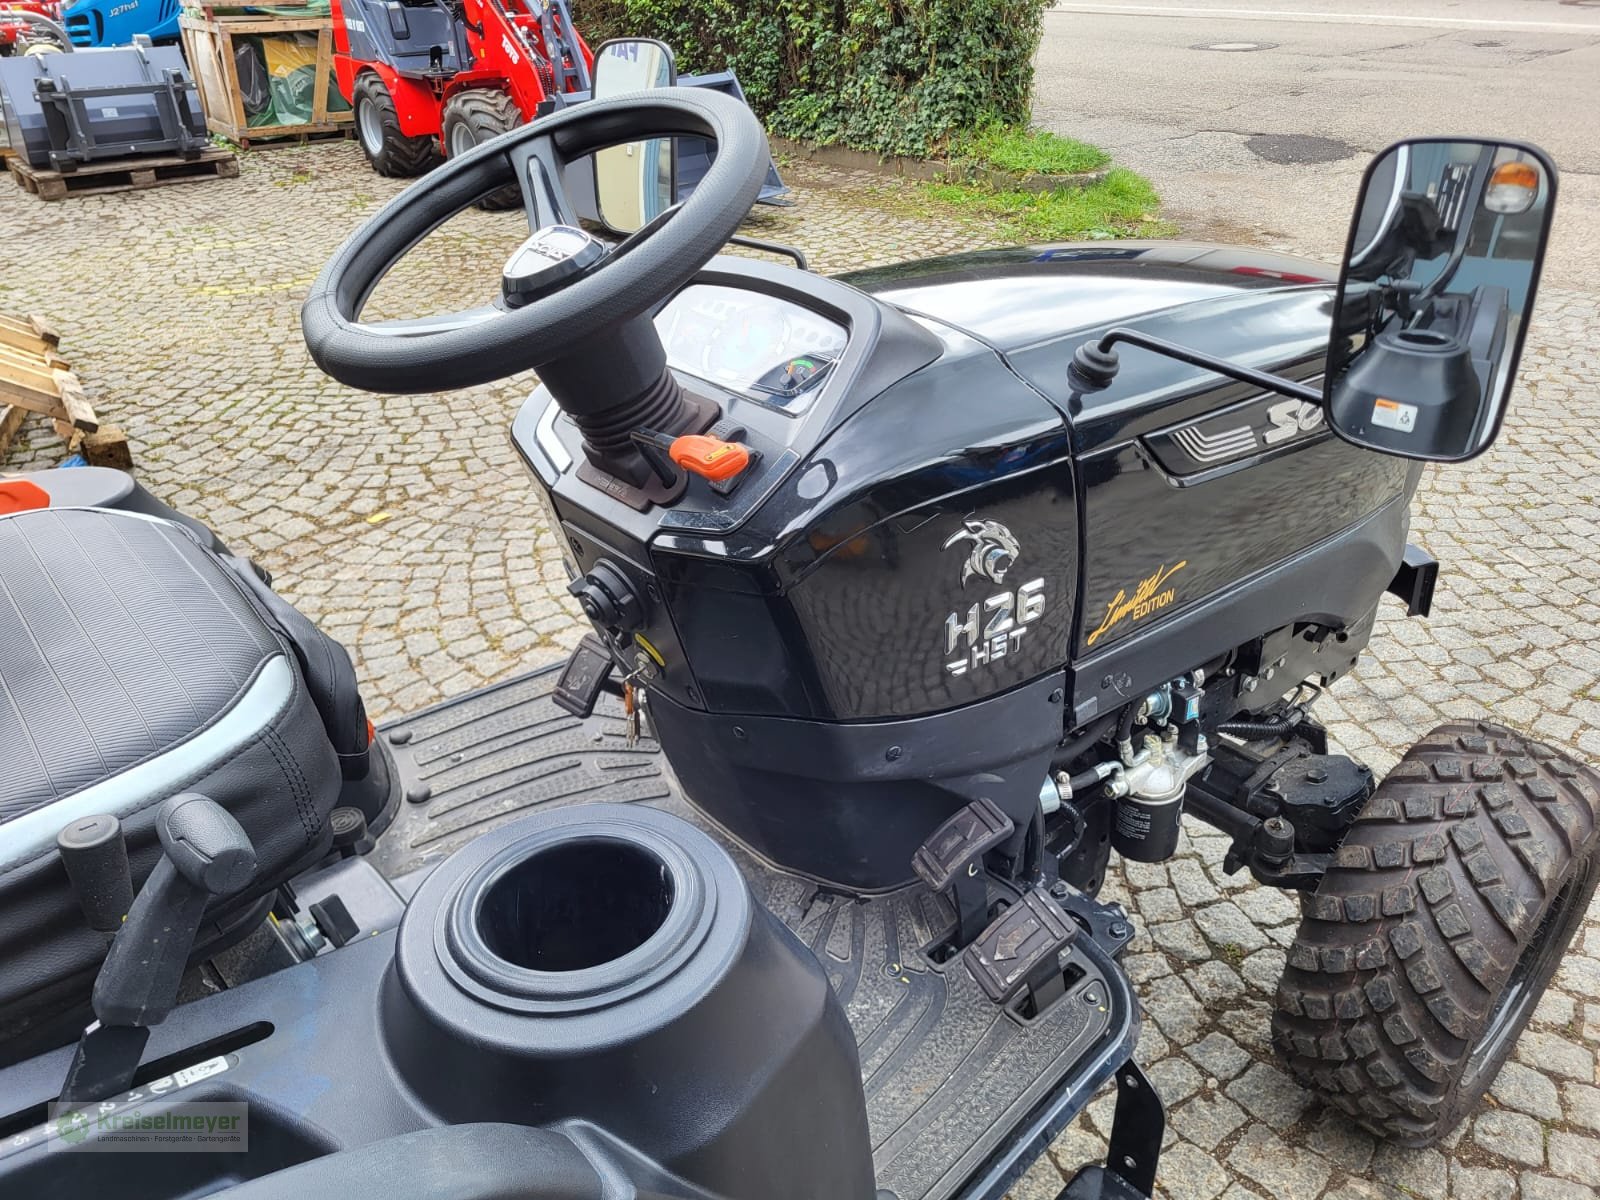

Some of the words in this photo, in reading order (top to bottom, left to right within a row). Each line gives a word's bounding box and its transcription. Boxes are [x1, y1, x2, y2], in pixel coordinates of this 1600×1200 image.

[944, 577, 1046, 655] H26
[1132, 588, 1175, 620] EDITION
[971, 626, 1027, 669] HST
